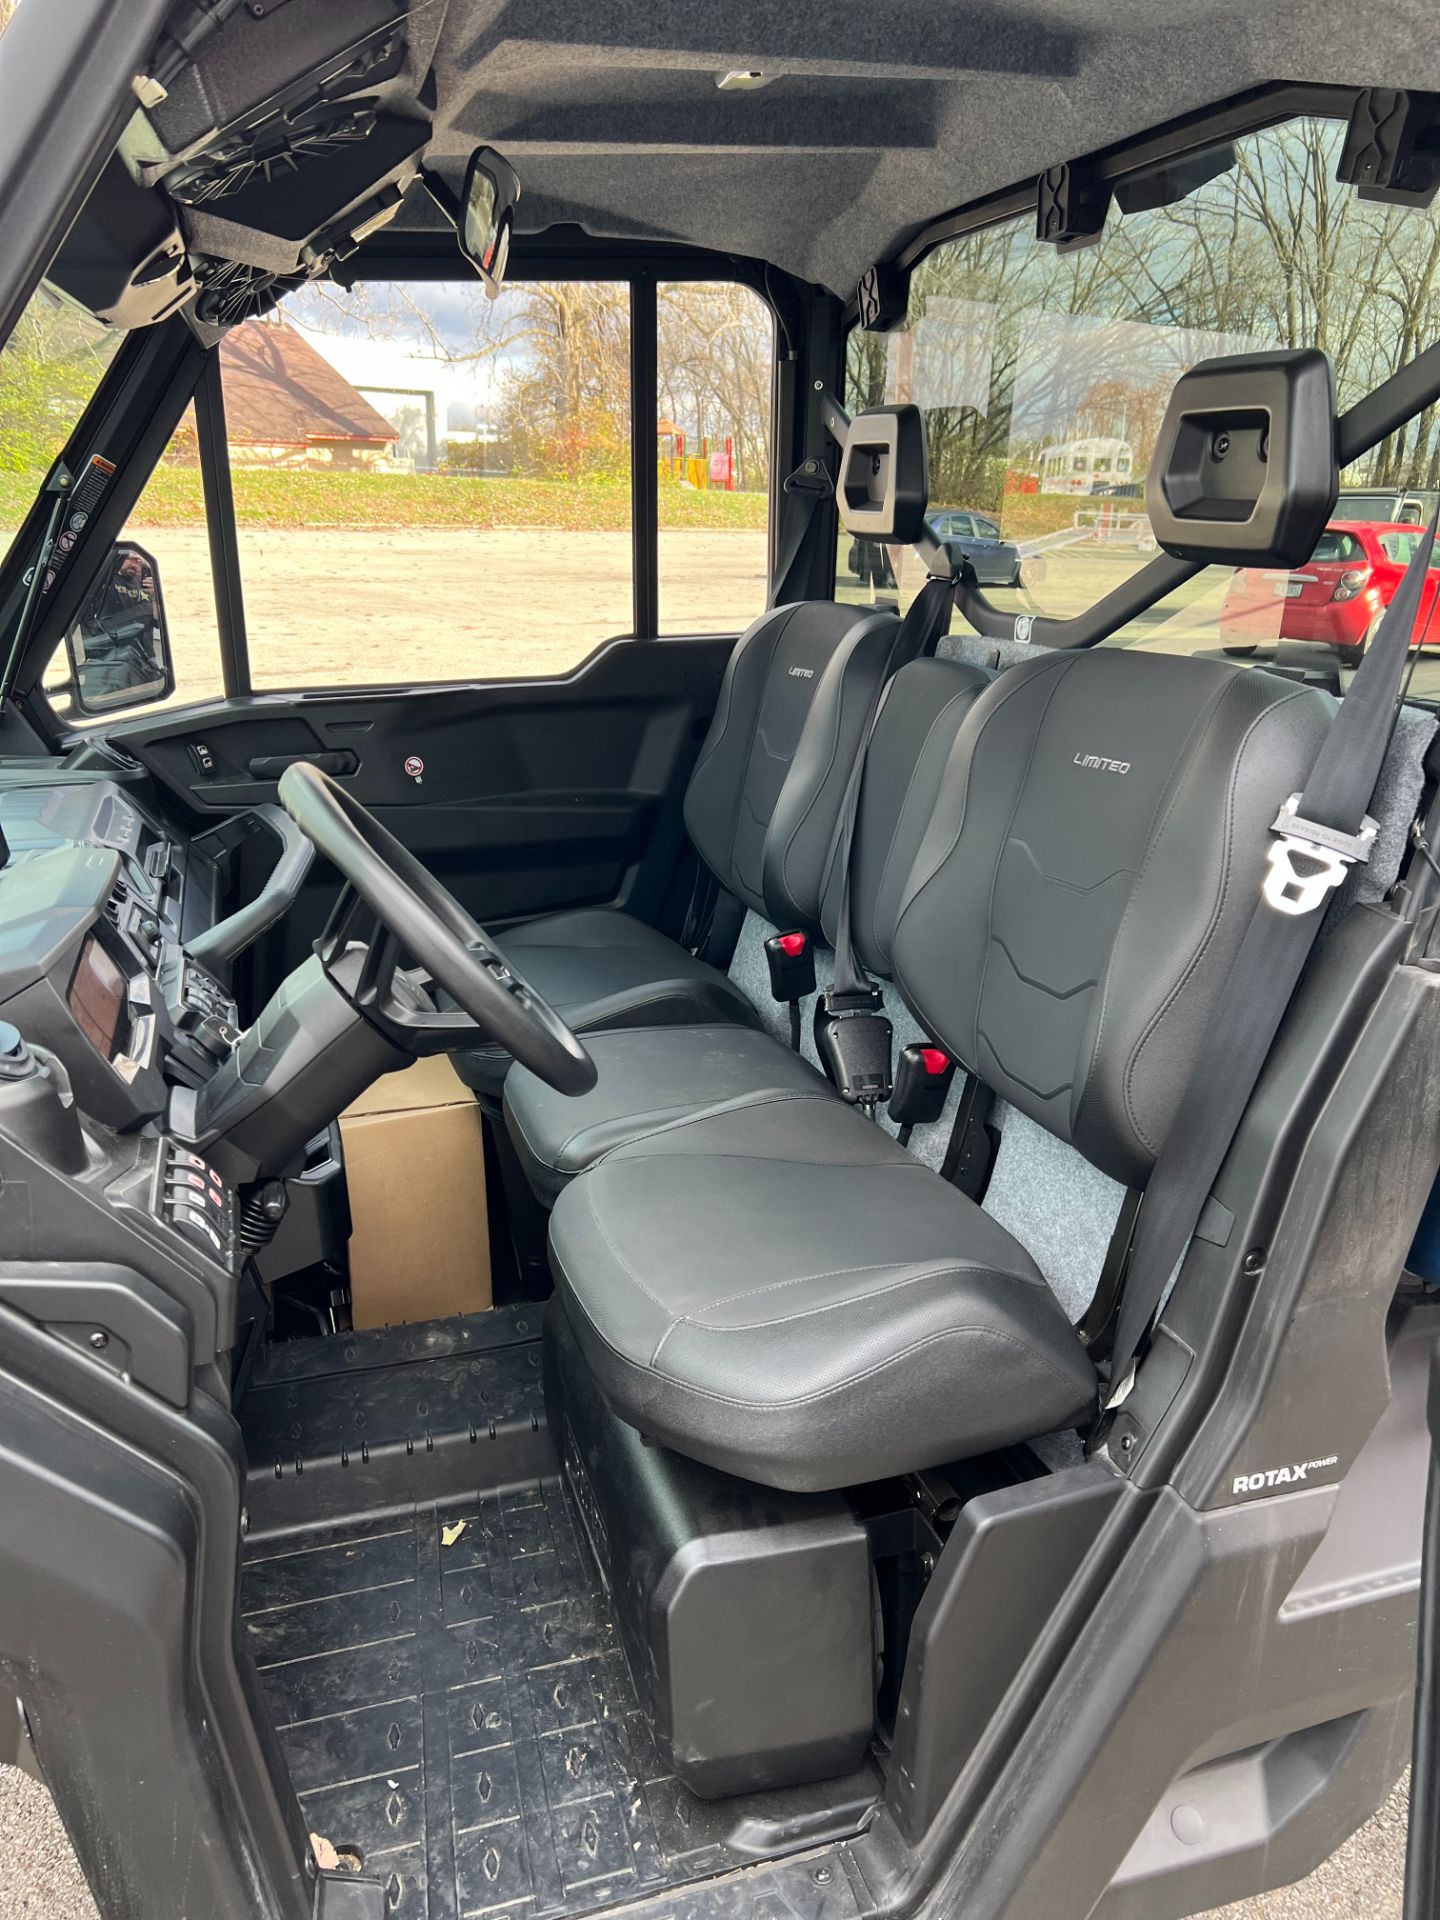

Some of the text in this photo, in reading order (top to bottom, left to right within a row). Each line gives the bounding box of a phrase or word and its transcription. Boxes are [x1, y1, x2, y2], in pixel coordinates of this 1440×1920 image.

[788, 666, 814, 678] LIMITED
[1073, 752, 1131, 774] LIMITED
[1232, 1456, 1338, 1494] ROTAX POWER
